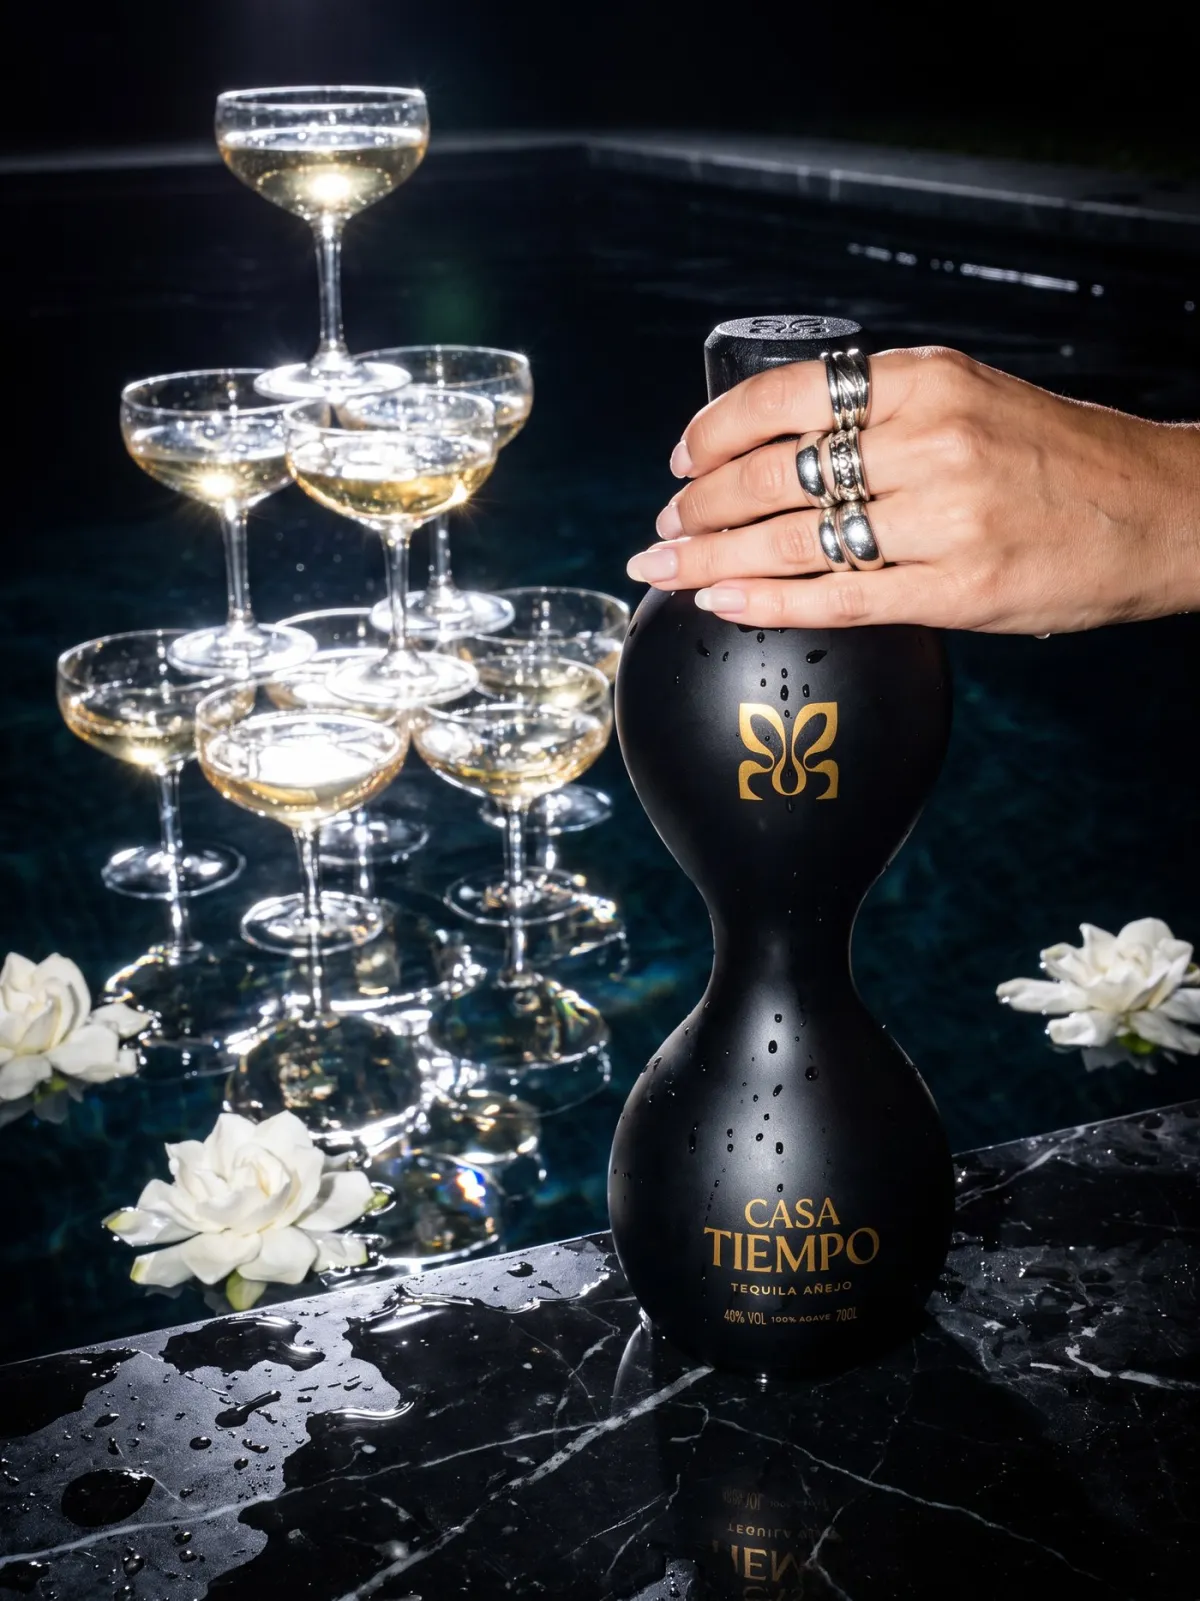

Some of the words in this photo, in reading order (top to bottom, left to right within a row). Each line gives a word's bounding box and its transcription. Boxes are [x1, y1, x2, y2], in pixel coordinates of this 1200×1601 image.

[744, 1197, 841, 1229] CASA
[703, 1227, 880, 1273] TIEMPO
[730, 1282, 797, 1296] TEQUILA
[803, 1280, 852, 1294] AÑEJO
[723, 1308, 745, 1324] 40%
[747, 1311, 767, 1325] VOL
[771, 1315, 797, 1323] 100%
[799, 1313, 831, 1323] AGAVE
